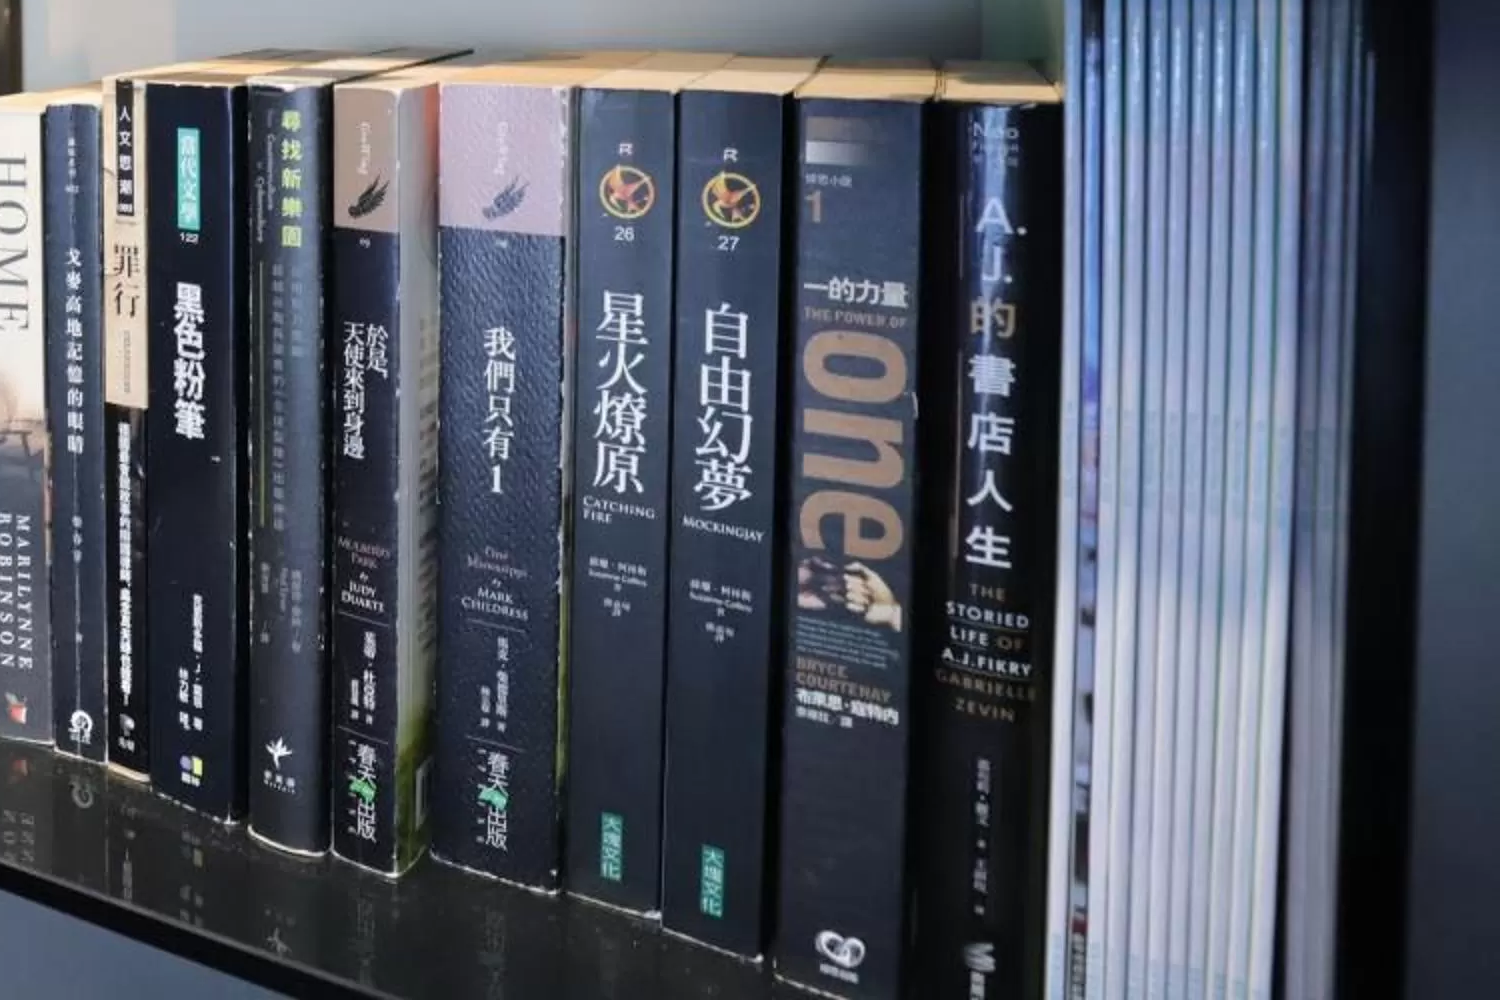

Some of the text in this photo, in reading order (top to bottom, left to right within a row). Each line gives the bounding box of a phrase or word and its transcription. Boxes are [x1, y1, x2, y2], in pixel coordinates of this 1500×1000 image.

[618, 141, 635, 157] R
[722, 147, 739, 163] R
[805, 190, 822, 225] 1
[716, 235, 741, 252] 27
[112, 243, 141, 319] 罪行
[802, 276, 910, 309] 一的力量
[803, 307, 908, 329] THE POWER OF
[173, 281, 207, 440] 黑色粉筆
[592, 289, 650, 495] 星火燎原
[693, 302, 753, 513] 自由幻夢
[800, 328, 907, 561] one
[581, 495, 656, 521] CATCHING
[582, 509, 614, 526] FIRE
[682, 515, 766, 544] MOCKINGJAY
[16, 513, 33, 669] MARILYNNE
[968, 582, 1006, 602] THE
[945, 600, 1030, 629] STORIED
[950, 624, 1024, 651] LIFE OF
[795, 656, 849, 679] BRYCE
[955, 696, 1016, 724] ZEVIN
